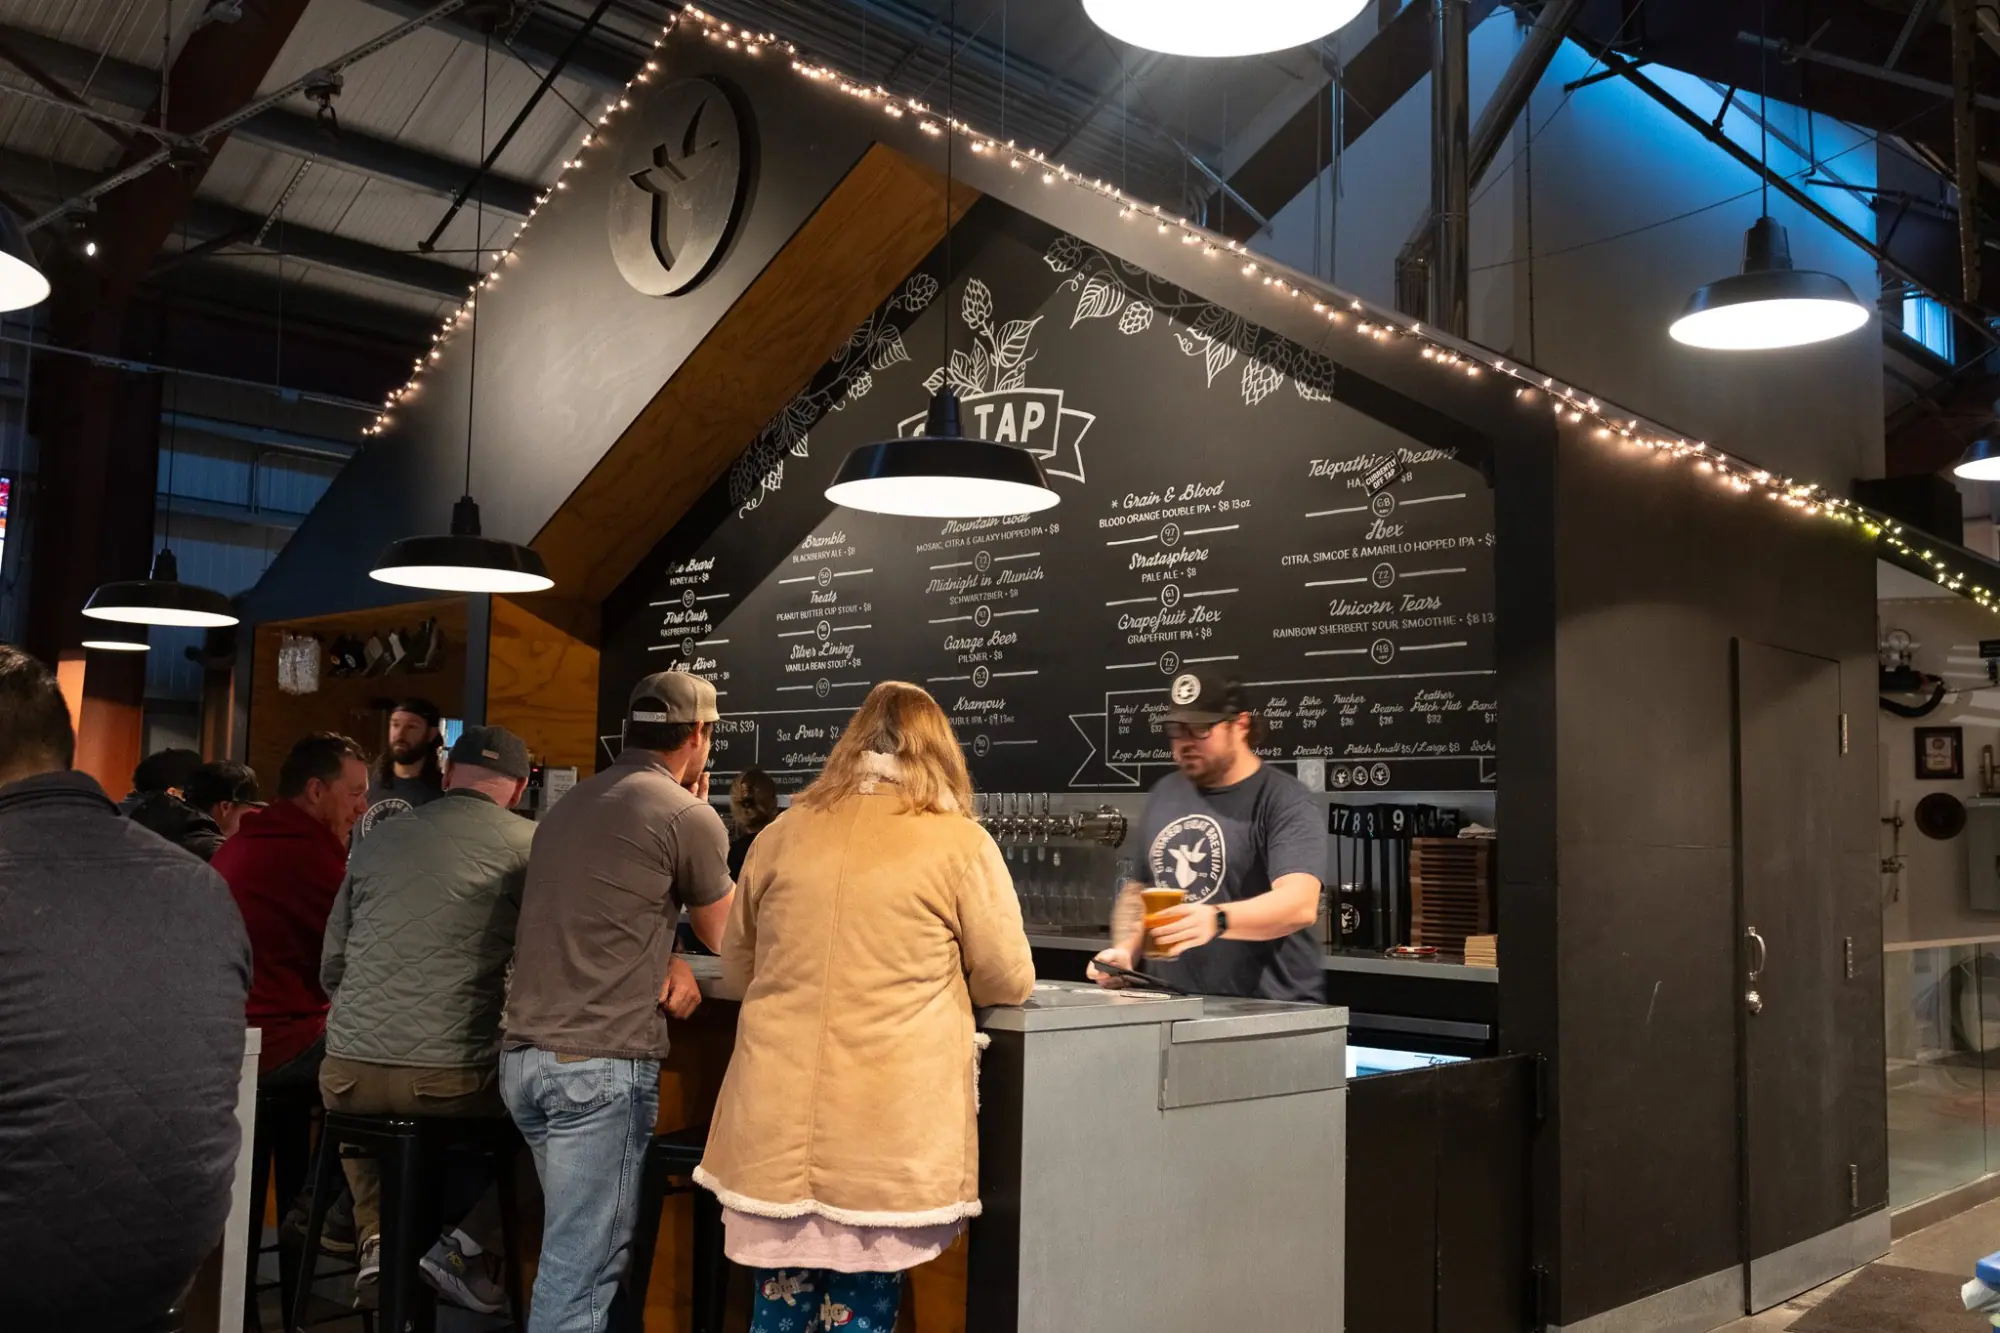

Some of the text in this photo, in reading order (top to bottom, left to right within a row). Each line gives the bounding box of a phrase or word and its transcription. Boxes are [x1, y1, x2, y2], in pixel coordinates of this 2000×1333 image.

[974, 401, 1045, 443] TAP
[1365, 459, 1397, 485] CURRENTLY
[1372, 468, 1396, 490] OFF TAP
[1122, 480, 1226, 509] Grain & Blood
[1098, 516, 1126, 528] BLOOD
[1127, 510, 1160, 524] ORANGE
[1162, 505, 1196, 519] DOUBLE
[1197, 503, 1211, 514] IPA
[1218, 500, 1230, 512] $8
[941, 516, 999, 535] Mountain
[1365, 518, 1404, 540] Ibex
[801, 530, 846, 549] Bramble
[944, 538, 965, 548] CITRA
[972, 531, 1001, 544] GALAXY
[1000, 527, 1031, 541] HOPPED
[1030, 526, 1043, 536] IPA
[1049, 523, 1060, 535] $8
[792, 551, 830, 564] BLACKBERRY
[830, 548, 842, 558] ALE
[1313, 549, 1349, 563] SIMCOE
[1351, 548, 1359, 558] &
[1360, 542, 1412, 557] AMARILLO
[1413, 538, 1455, 552] HOPPED
[1458, 536, 1475, 547] IPA
[685, 556, 715, 572] Beard
[1129, 546, 1209, 570] Stratasphere
[669, 576, 687, 586] HONEY
[687, 575, 698, 584] ALE
[925, 565, 1044, 594] Midnight in Munich
[1141, 567, 1197, 583] PALE ALE $8
[810, 590, 837, 604] Treats
[949, 588, 1019, 606] SCHWARTZBIER $8
[1329, 593, 1442, 616] Unicorn Tears
[663, 609, 708, 625] First Crush
[776, 611, 799, 621] PEANUT
[800, 609, 824, 620] BUTTER
[824, 606, 837, 616] CUP
[838, 604, 858, 614] STOUT
[1117, 605, 1222, 633] Grapefruit Ibex
[660, 626, 690, 637] RASPBERRY
[690, 625, 701, 634] ALE
[1273, 614, 1480, 639] RAINBOW SHERBERT SOUR SMOOTHIE $8
[943, 630, 1018, 653] Garage Beer
[1127, 627, 1213, 645] GRAPEFRUIT IPA $8
[790, 641, 855, 659] Silver Lining
[958, 650, 1003, 663] PILSNER $8
[692, 657, 717, 670] River
[785, 663, 809, 672] VANILLA
[810, 661, 826, 671] BEAN
[827, 659, 847, 669] STOUT
[1267, 697, 1288, 707] Kids
[1299, 696, 1323, 706] Bike
[1332, 693, 1366, 704] Trucker
[1414, 689, 1454, 701] Leather
[952, 696, 1006, 714] Krampus
[1140, 702, 1169, 713] Baseba
[1263, 708, 1292, 718] Clothes
[1295, 706, 1328, 719] Jerseys
[1339, 705, 1359, 715] Hat
[1370, 703, 1404, 714] Beanie
[1409, 700, 1462, 712] Patch Hat
[948, 715, 969, 726] OUBLE
[971, 715, 983, 724] IPA
[1484, 712, 1498, 723] $1
[715, 720, 755, 734] 3 FOR $39
[776, 724, 840, 742] 3oz Pours $2
[715, 739, 729, 752] $19
[1343, 743, 1374, 754] Patch
[1373, 742, 1400, 754] Small
[797, 752, 829, 766] Certificate
[1112, 749, 1133, 762] Logo
[1332, 808, 1349, 831] 17
[1352, 812, 1361, 832] 8
[1367, 812, 1374, 832] 3
[1392, 809, 1405, 832] 9
[1205, 826, 1221, 880] BREWING
